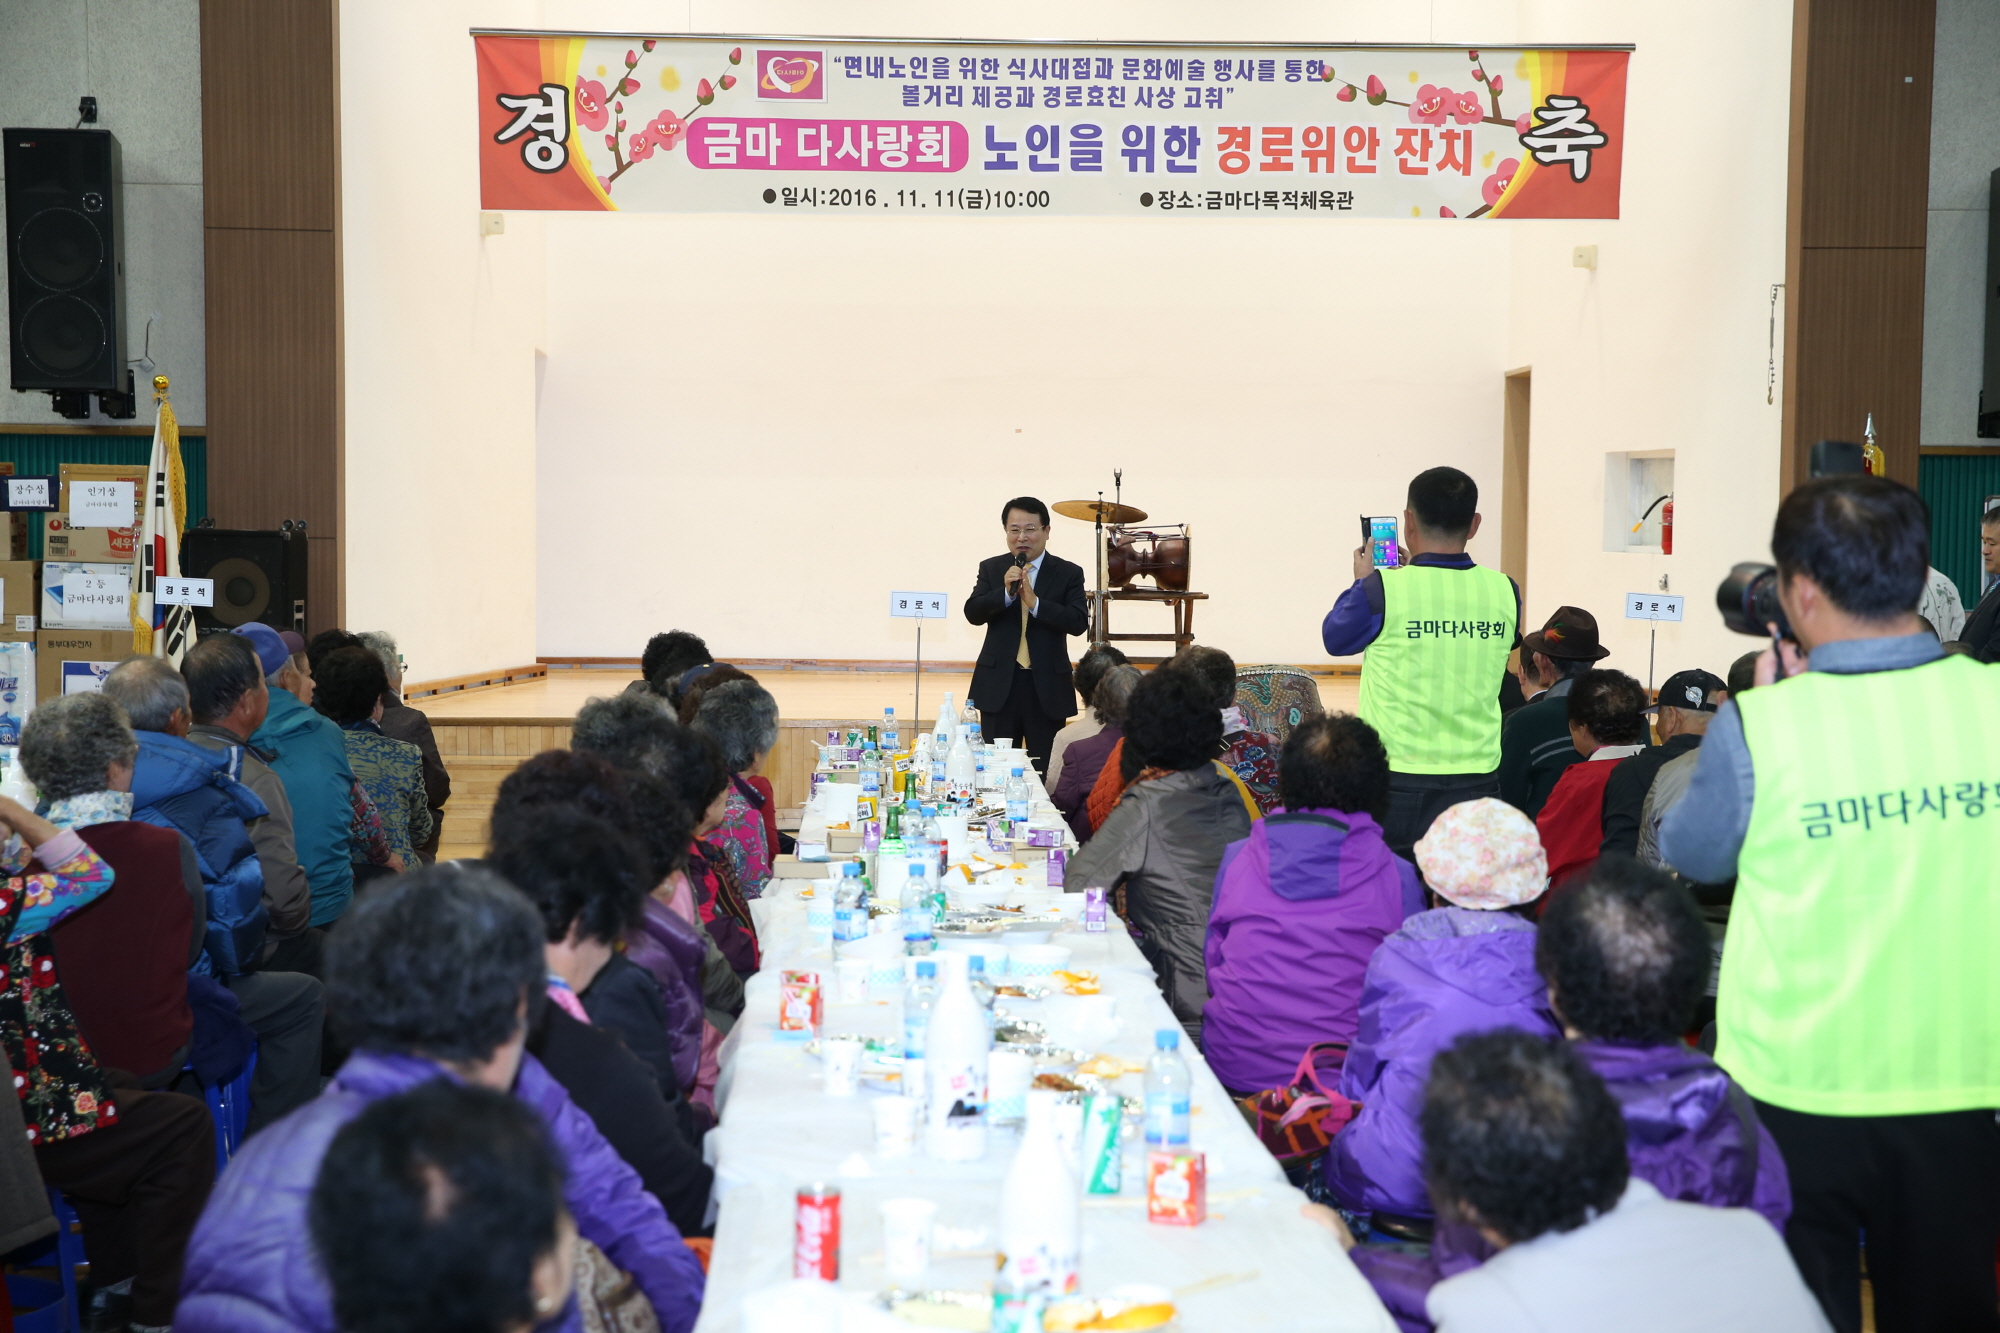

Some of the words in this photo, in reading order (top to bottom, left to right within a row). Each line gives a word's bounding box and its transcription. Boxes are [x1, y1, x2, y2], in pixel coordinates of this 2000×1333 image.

[959, 57, 1000, 80] 위한
[1007, 58, 1114, 81] 식사대접과
[1122, 58, 1205, 81] 문화예술
[1214, 59, 1275, 82] 행사를
[1285, 60, 1326, 82] 통한
[902, 85, 963, 107] 볼거리
[972, 85, 1035, 108] 제공과
[1043, 86, 1126, 108] 경로효친
[1134, 86, 1176, 109] 사상
[495, 83, 570, 174] 경
[1518, 94, 1608, 183] 축
[703, 123, 782, 166] 금마
[797, 124, 951, 168] 다사랑회
[984, 124, 1103, 172] 노인을
[1121, 125, 1201, 173] 위한
[1217, 126, 1380, 174] 경로위안
[1395, 127, 1473, 176] 잔치
[88, 487, 116, 496] 인기상
[66, 594, 124, 605] 금마다사랑회
[165, 585, 205, 597] 경로석
[898, 599, 939, 610] 경로석
[1634, 601, 1676, 613] 경로석
[1405, 620, 1506, 640] 금마다사랑회
[1801, 780, 2000, 839] 금마다사랑
